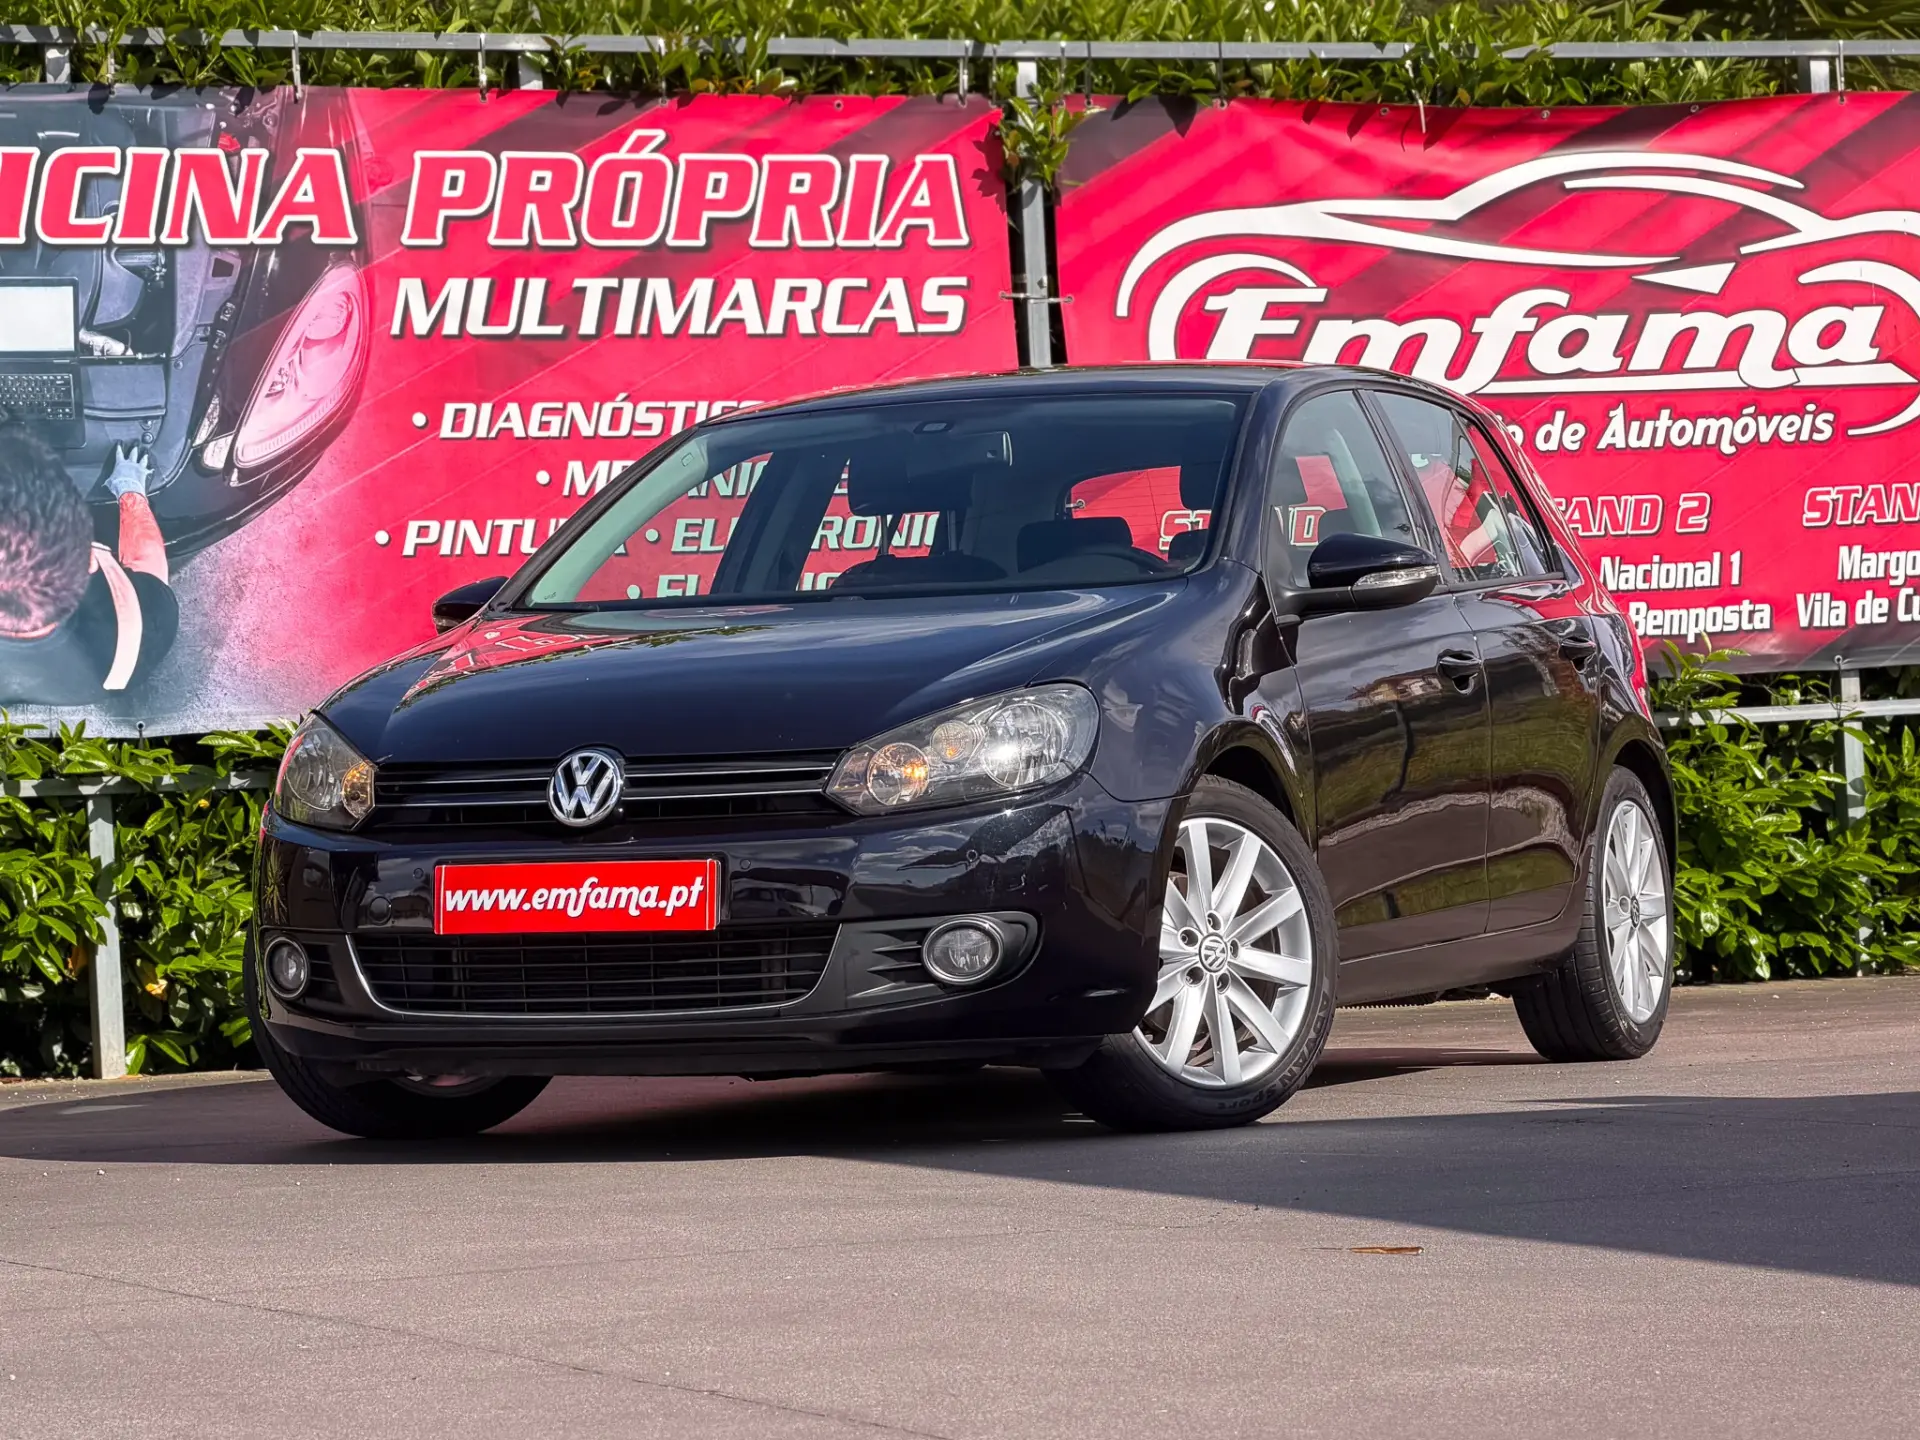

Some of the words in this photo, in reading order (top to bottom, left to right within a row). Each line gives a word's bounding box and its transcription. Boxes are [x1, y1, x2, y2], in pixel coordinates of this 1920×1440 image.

[400, 129, 969, 248] PRÓPRIA
[390, 275, 968, 337] MULTIMARCAS
[1203, 287, 1885, 393] Emfama
[1535, 410, 1587, 452] de
[1675, 492, 1711, 533] 2
[1600, 551, 1722, 592] Nacional
[1730, 550, 1742, 586] 1
[1837, 544, 1920, 586] Margo
[1629, 599, 1771, 643] Bemposta
[1796, 592, 1847, 628] Vila
[1855, 590, 1889, 625] de
[445, 876, 705, 917] www.emfama.pt
